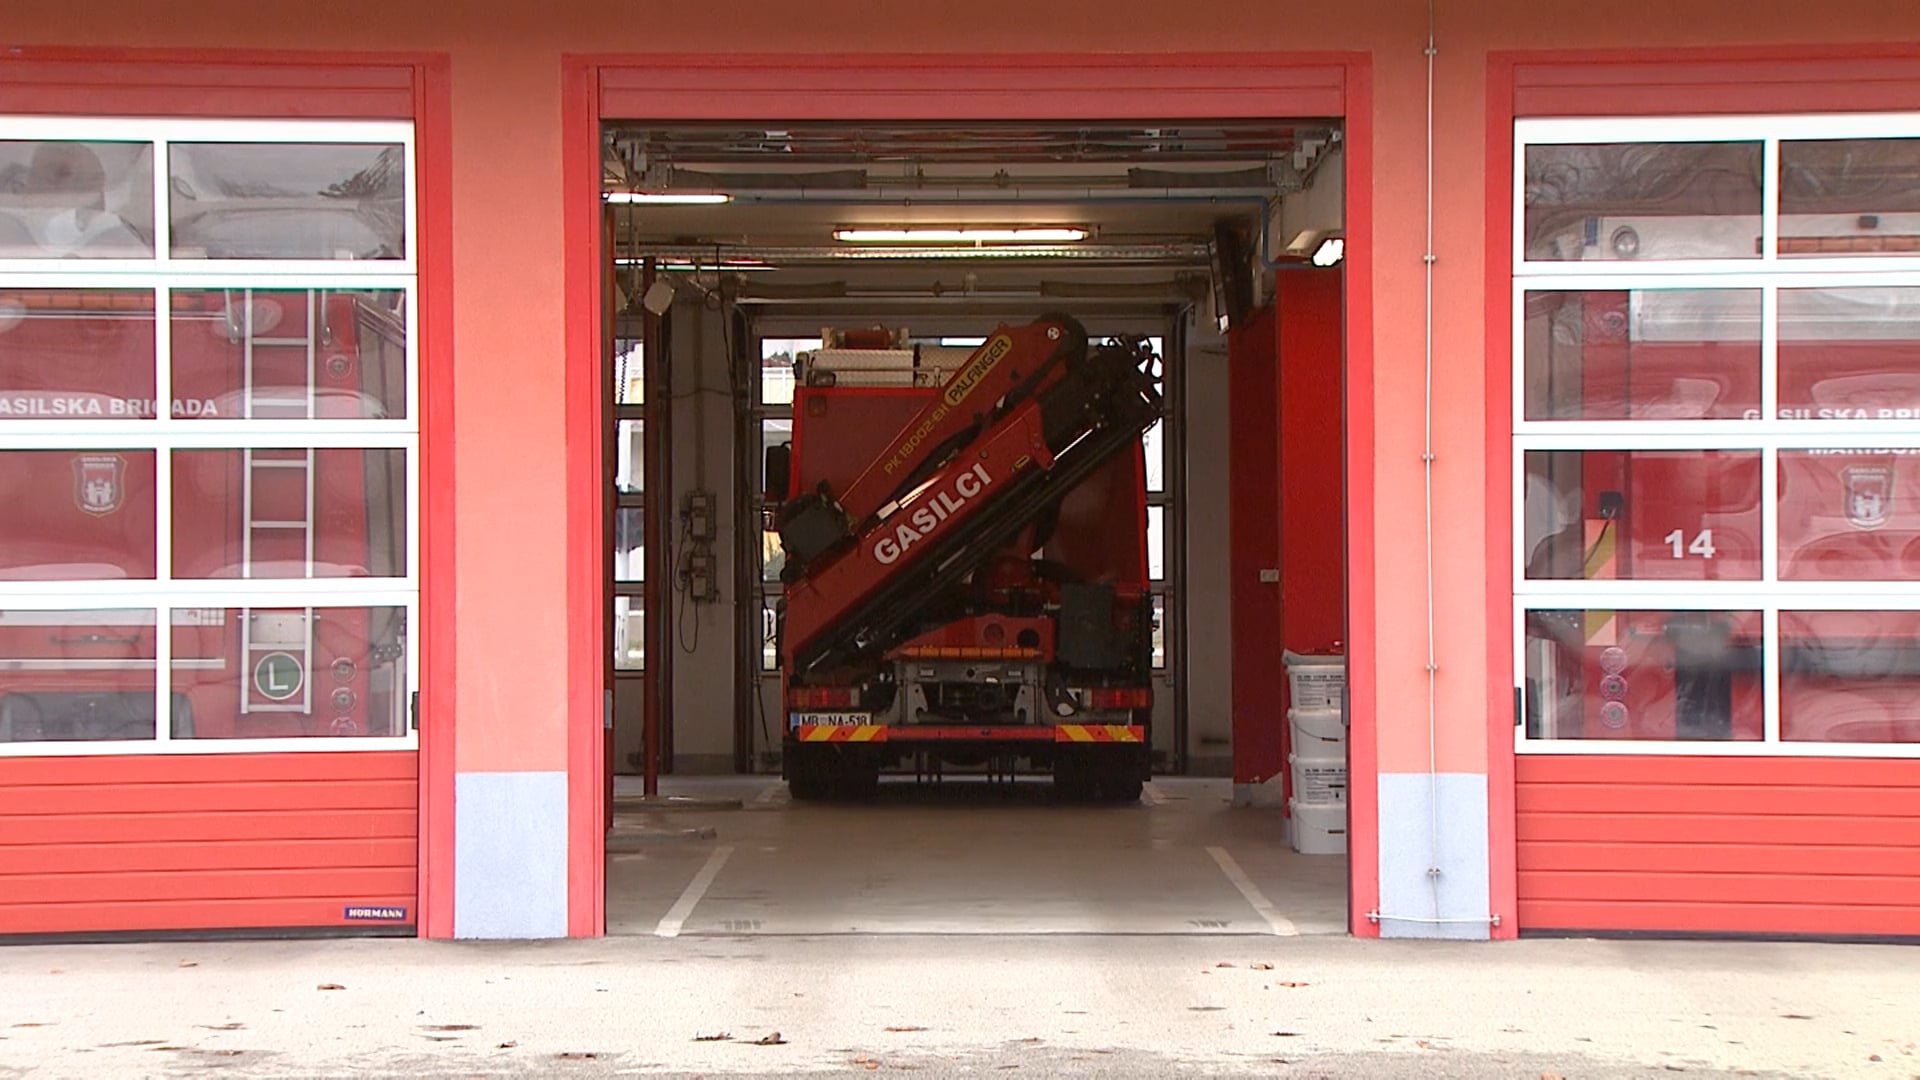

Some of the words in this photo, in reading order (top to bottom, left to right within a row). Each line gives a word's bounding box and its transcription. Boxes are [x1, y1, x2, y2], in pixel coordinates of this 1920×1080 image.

[949, 339, 1009, 402] PALFINGER
[110, 398, 218, 415] BRIADA
[884, 456, 901, 475] PK
[874, 463, 992, 564] GASILCI
[1664, 529, 1716, 558] 14
[269, 662, 289, 690] L
